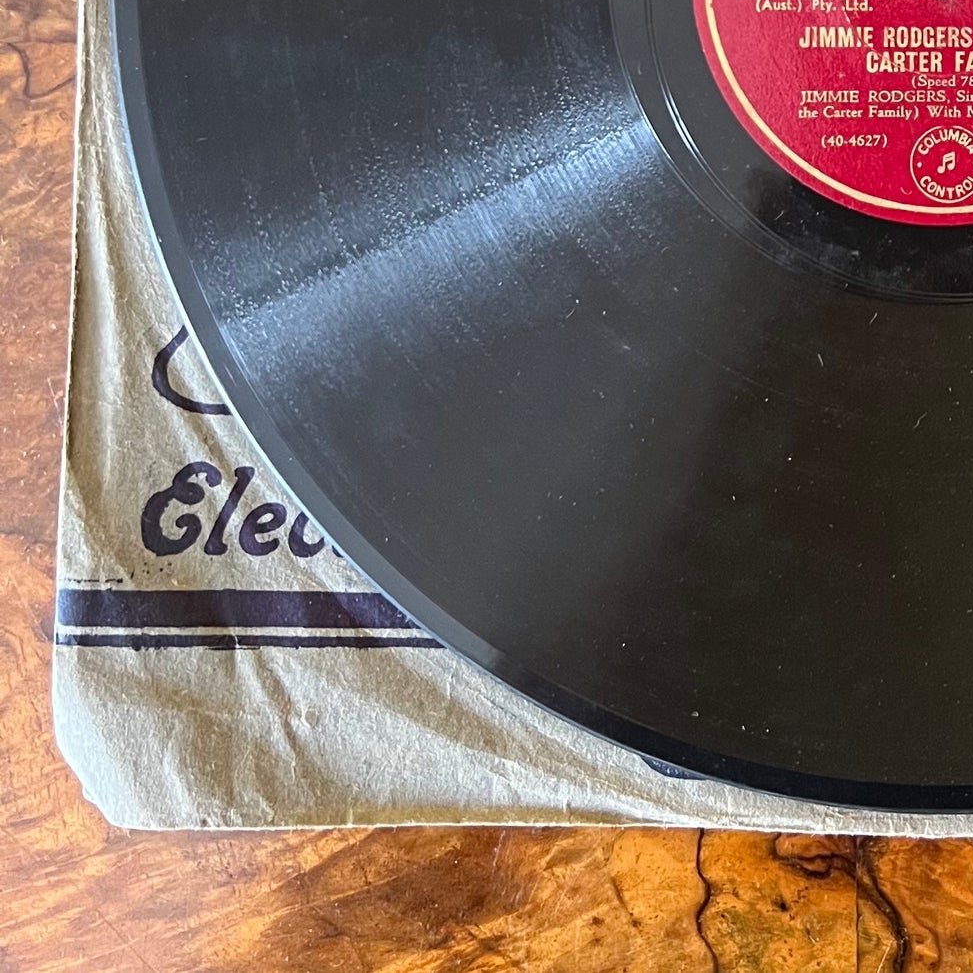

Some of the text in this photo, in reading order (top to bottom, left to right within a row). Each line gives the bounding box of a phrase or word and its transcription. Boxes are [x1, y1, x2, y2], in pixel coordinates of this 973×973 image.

[812, 0, 837, 13] Pty.
[844, 0, 874, 12] Ltd.
[799, 26, 874, 48] JIMMIE
[883, 26, 973, 48] RODGERS
[865, 51, 943, 73] CARTER
[911, 75, 956, 88] (Speed
[800, 90, 860, 104] JIMMIE
[868, 90, 951, 104] RODGERS,
[798, 107, 822, 118] the
[822, 107, 863, 118] Carter
[868, 106, 919, 120] Family)
[928, 106, 962, 118] With
[821, 133, 888, 148] (40-4627)
[140, 460, 343, 558] Elec
